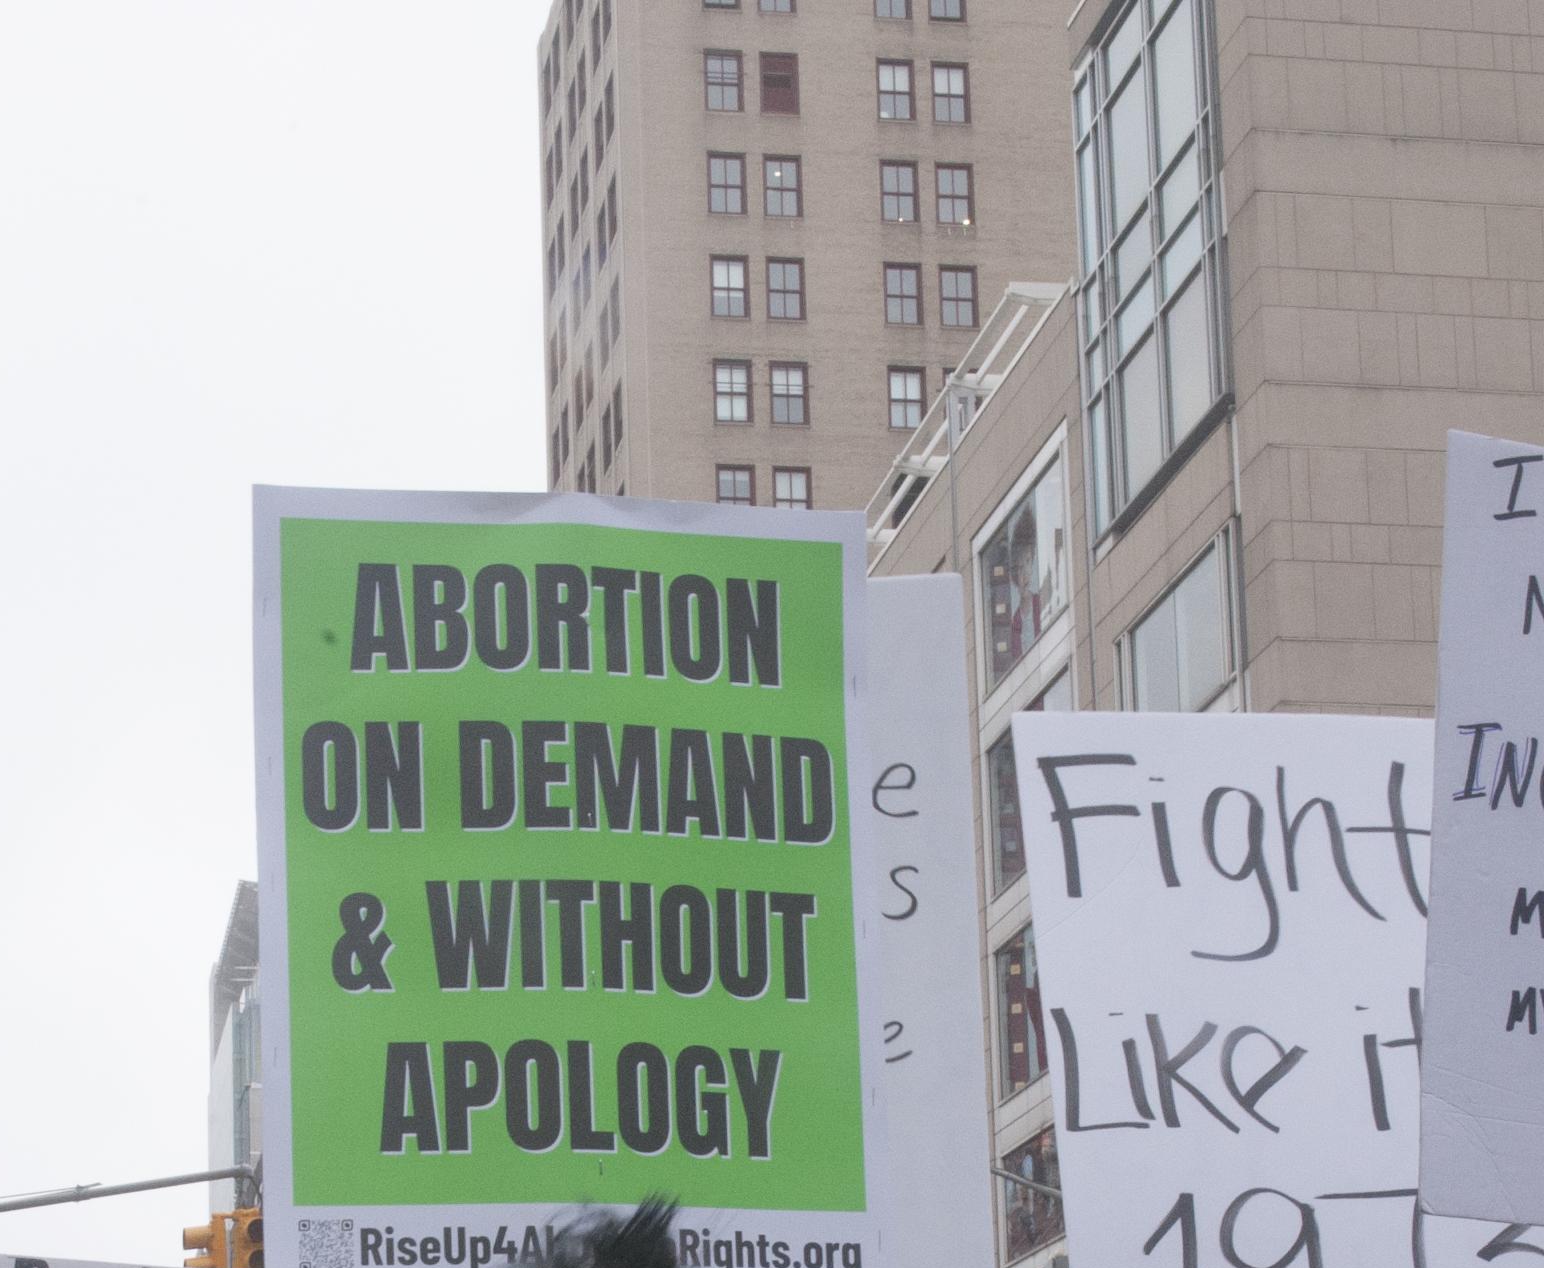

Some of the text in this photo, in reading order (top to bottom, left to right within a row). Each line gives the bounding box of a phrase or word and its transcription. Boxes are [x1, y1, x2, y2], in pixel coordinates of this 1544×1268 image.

[349, 562, 782, 688] ABORTION
[300, 720, 834, 847] ON DEMAND
[1453, 722, 1544, 810] IN
[1037, 754, 1431, 961] Fight
[330, 879, 816, 1003] & WITHOUT
[1506, 986, 1544, 1035] M
[379, 1039, 782, 1161] APOLOGY
